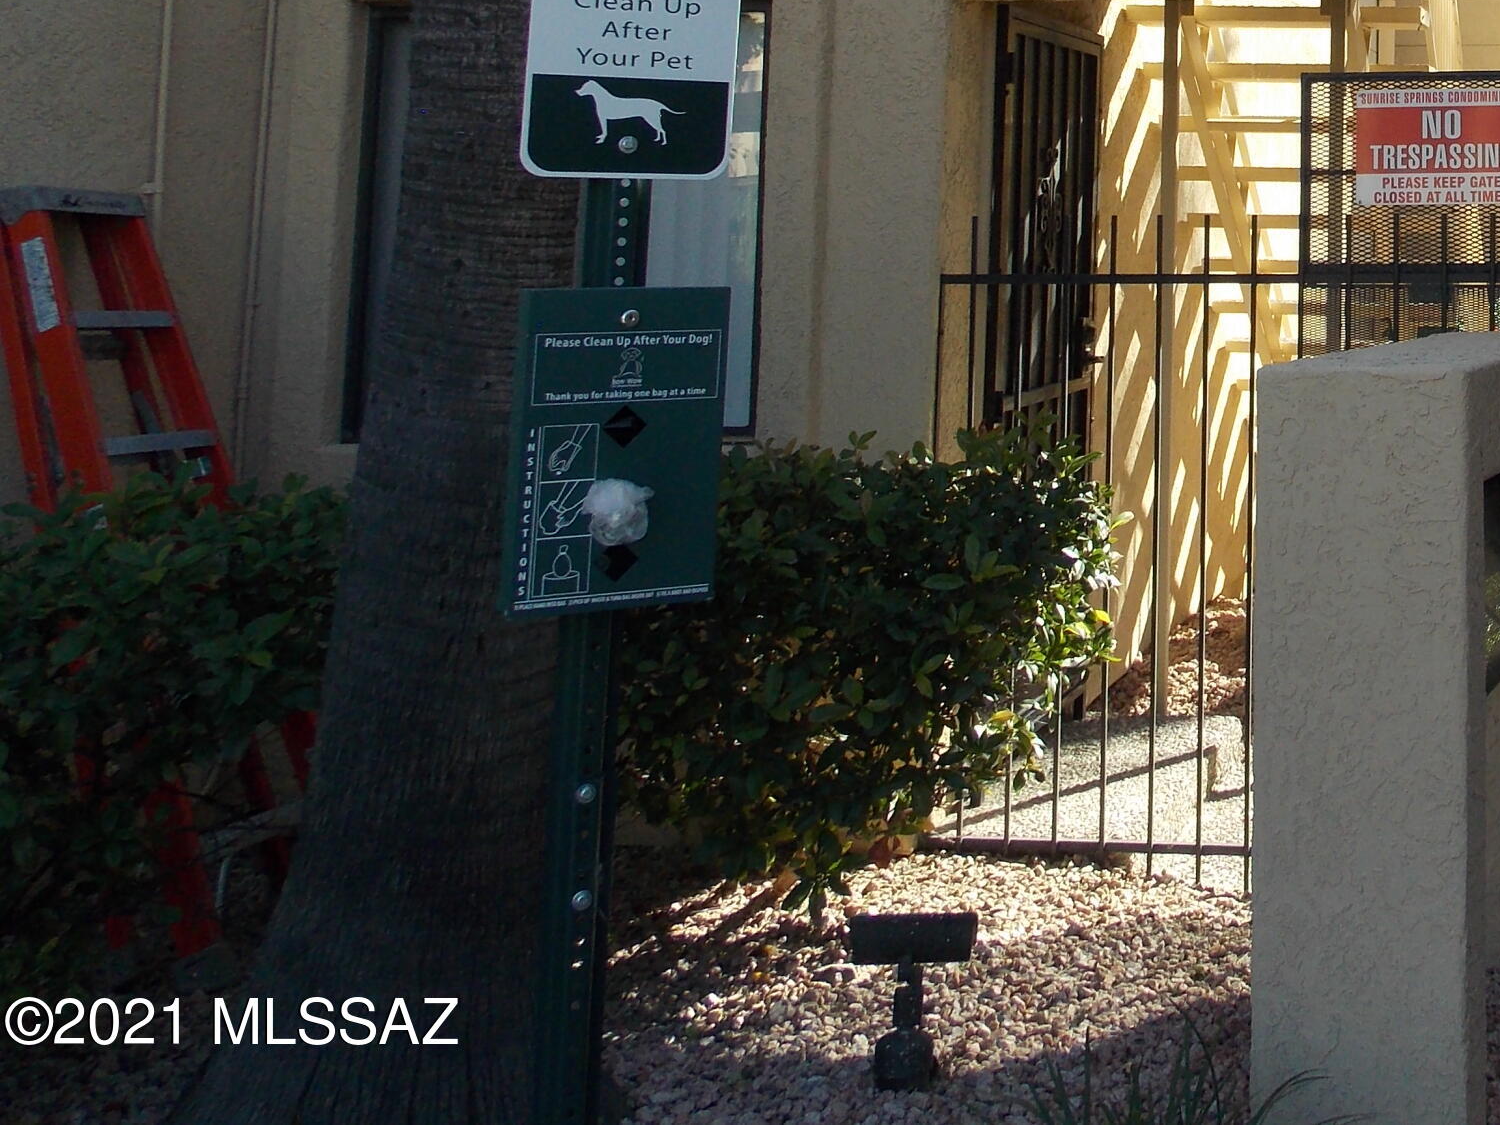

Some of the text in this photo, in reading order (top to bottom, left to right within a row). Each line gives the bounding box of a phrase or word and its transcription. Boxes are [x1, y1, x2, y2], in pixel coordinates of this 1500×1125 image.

[602, 21, 672, 41] After
[576, 47, 693, 70] Your Pet
[1361, 92, 1400, 105] SUNRISE
[1404, 91, 1444, 104] SPRINGS
[1421, 109, 1462, 139] NO
[1382, 176, 1500, 189] PLEASE KEEP GATE
[1374, 191, 1422, 204] CLOSED
[1426, 191, 1441, 203] AT
[1444, 191, 1467, 203] ALL
[545, 334, 713, 348] Please Clean Up After Your Dog!
[545, 391, 571, 401] Thank
[572, 392, 589, 402] you
[591, 390, 603, 399] for
[605, 390, 633, 400] taking
[634, 389, 650, 397] one
[652, 387, 668, 399] bag
[669, 388, 678, 396] at
[686, 387, 706, 395] time
[518, 428, 535, 596] INSTRUCTIONS
